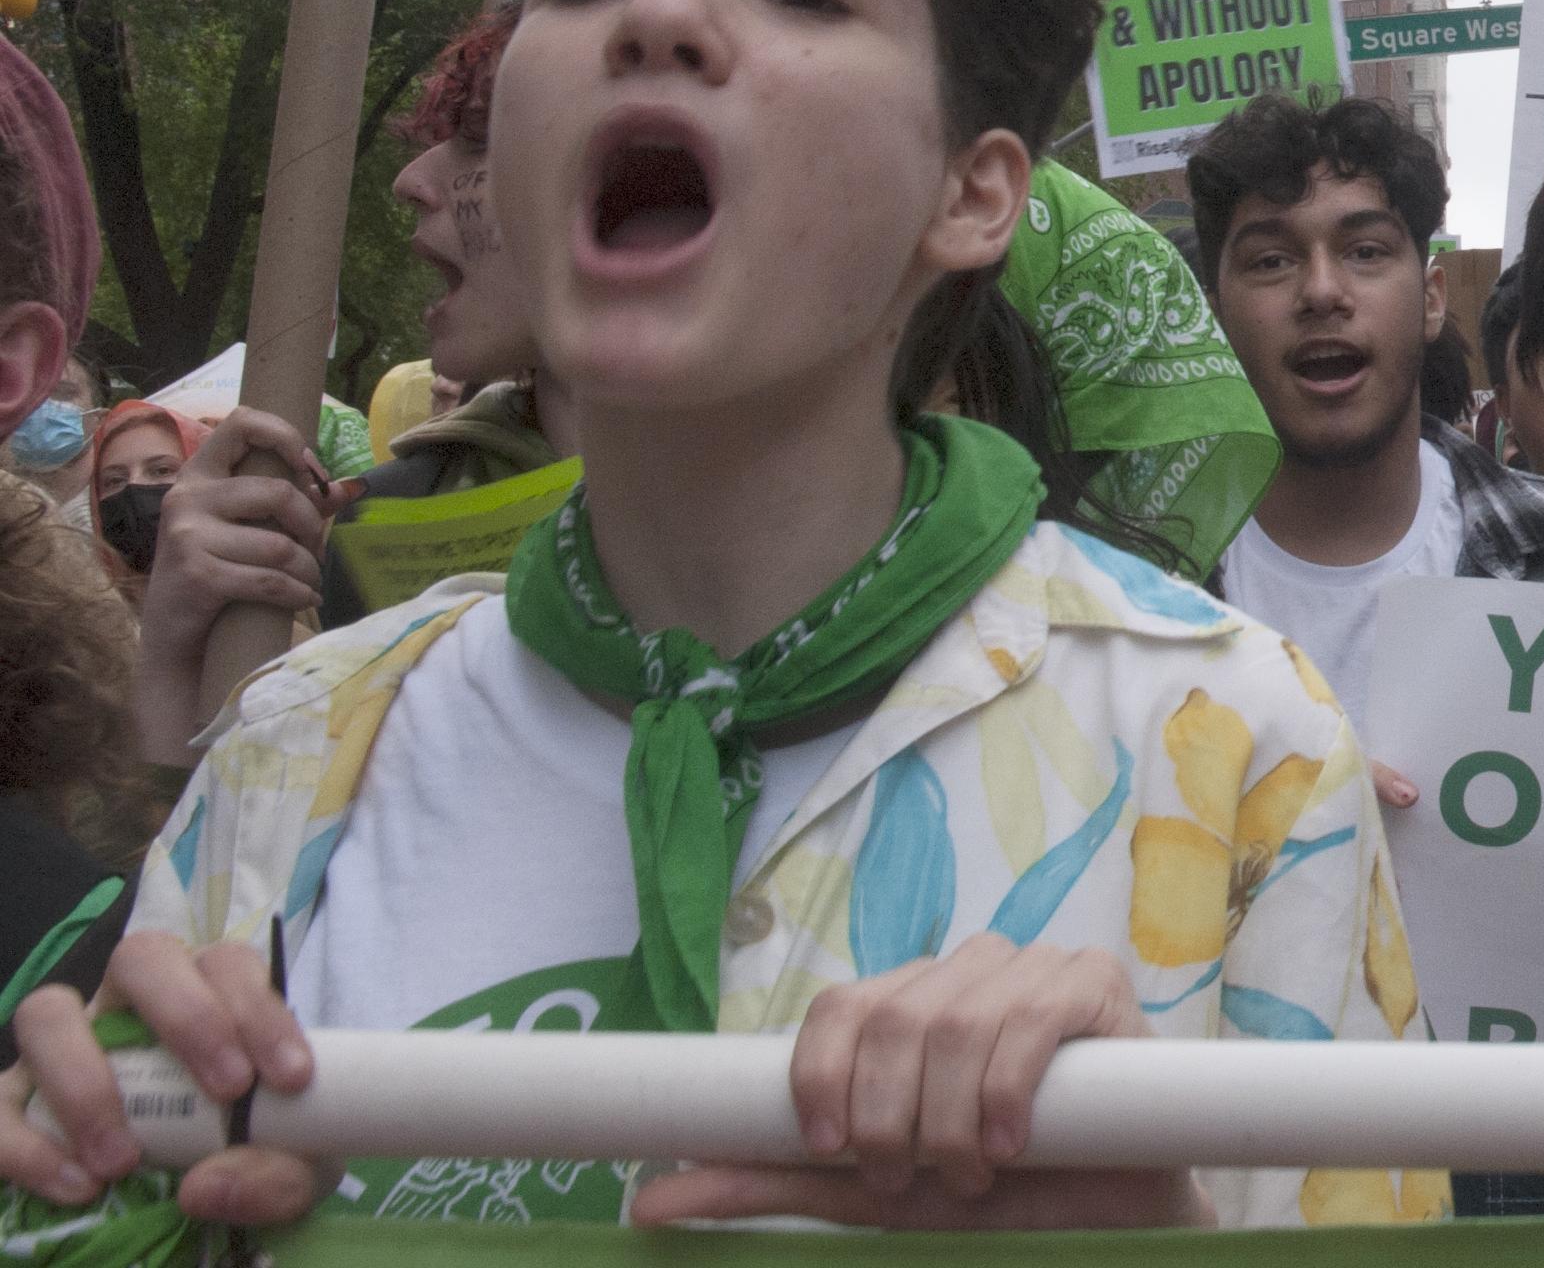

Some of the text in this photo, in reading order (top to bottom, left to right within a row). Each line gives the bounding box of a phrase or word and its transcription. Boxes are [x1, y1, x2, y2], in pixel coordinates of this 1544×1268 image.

[1111, 7, 1137, 48] &
[1361, 26, 1457, 53] Square
[1465, 19, 1522, 41] Wes
[1138, 46, 1303, 112] APOLOGY
